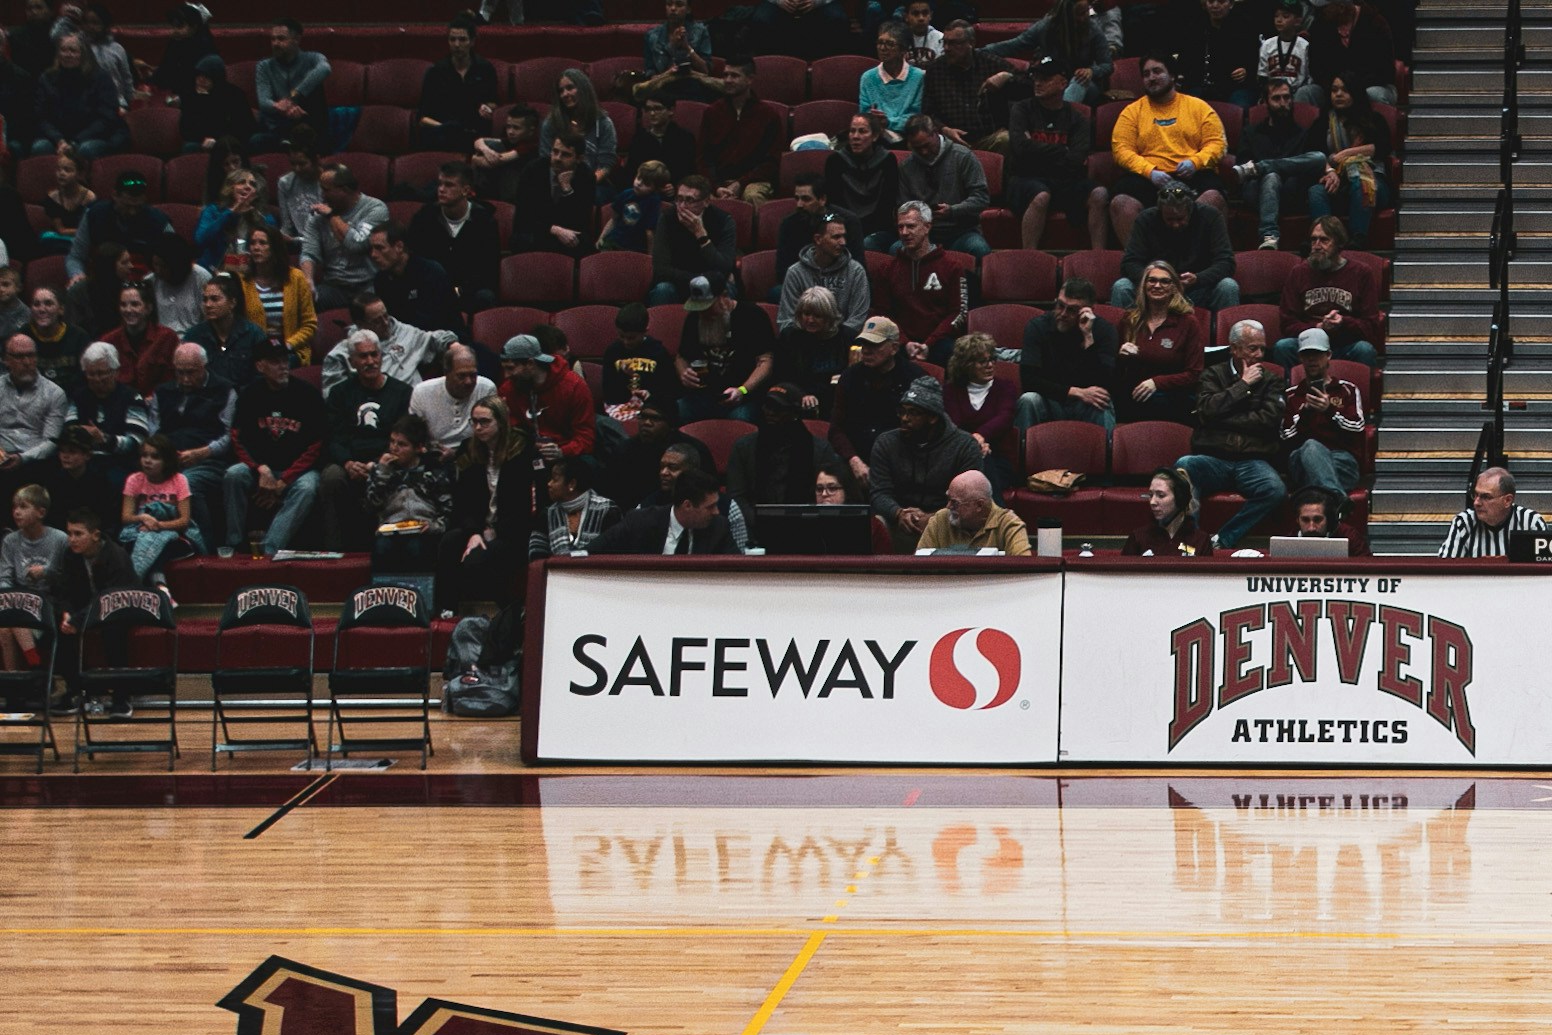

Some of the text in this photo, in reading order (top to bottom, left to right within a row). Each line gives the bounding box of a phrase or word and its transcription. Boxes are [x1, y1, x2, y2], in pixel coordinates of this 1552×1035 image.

[1304, 286, 1353, 312] DENVER
[1247, 577, 1402, 594] UNIVERSITY OF
[100, 589, 161, 621] DENVER
[237, 588, 298, 619] DENVER
[353, 586, 417, 620] DENVER
[568, 633, 918, 699] SAFEWAY
[1167, 598, 1476, 758] DENVER
[1231, 718, 1408, 743] ATHLETICS
